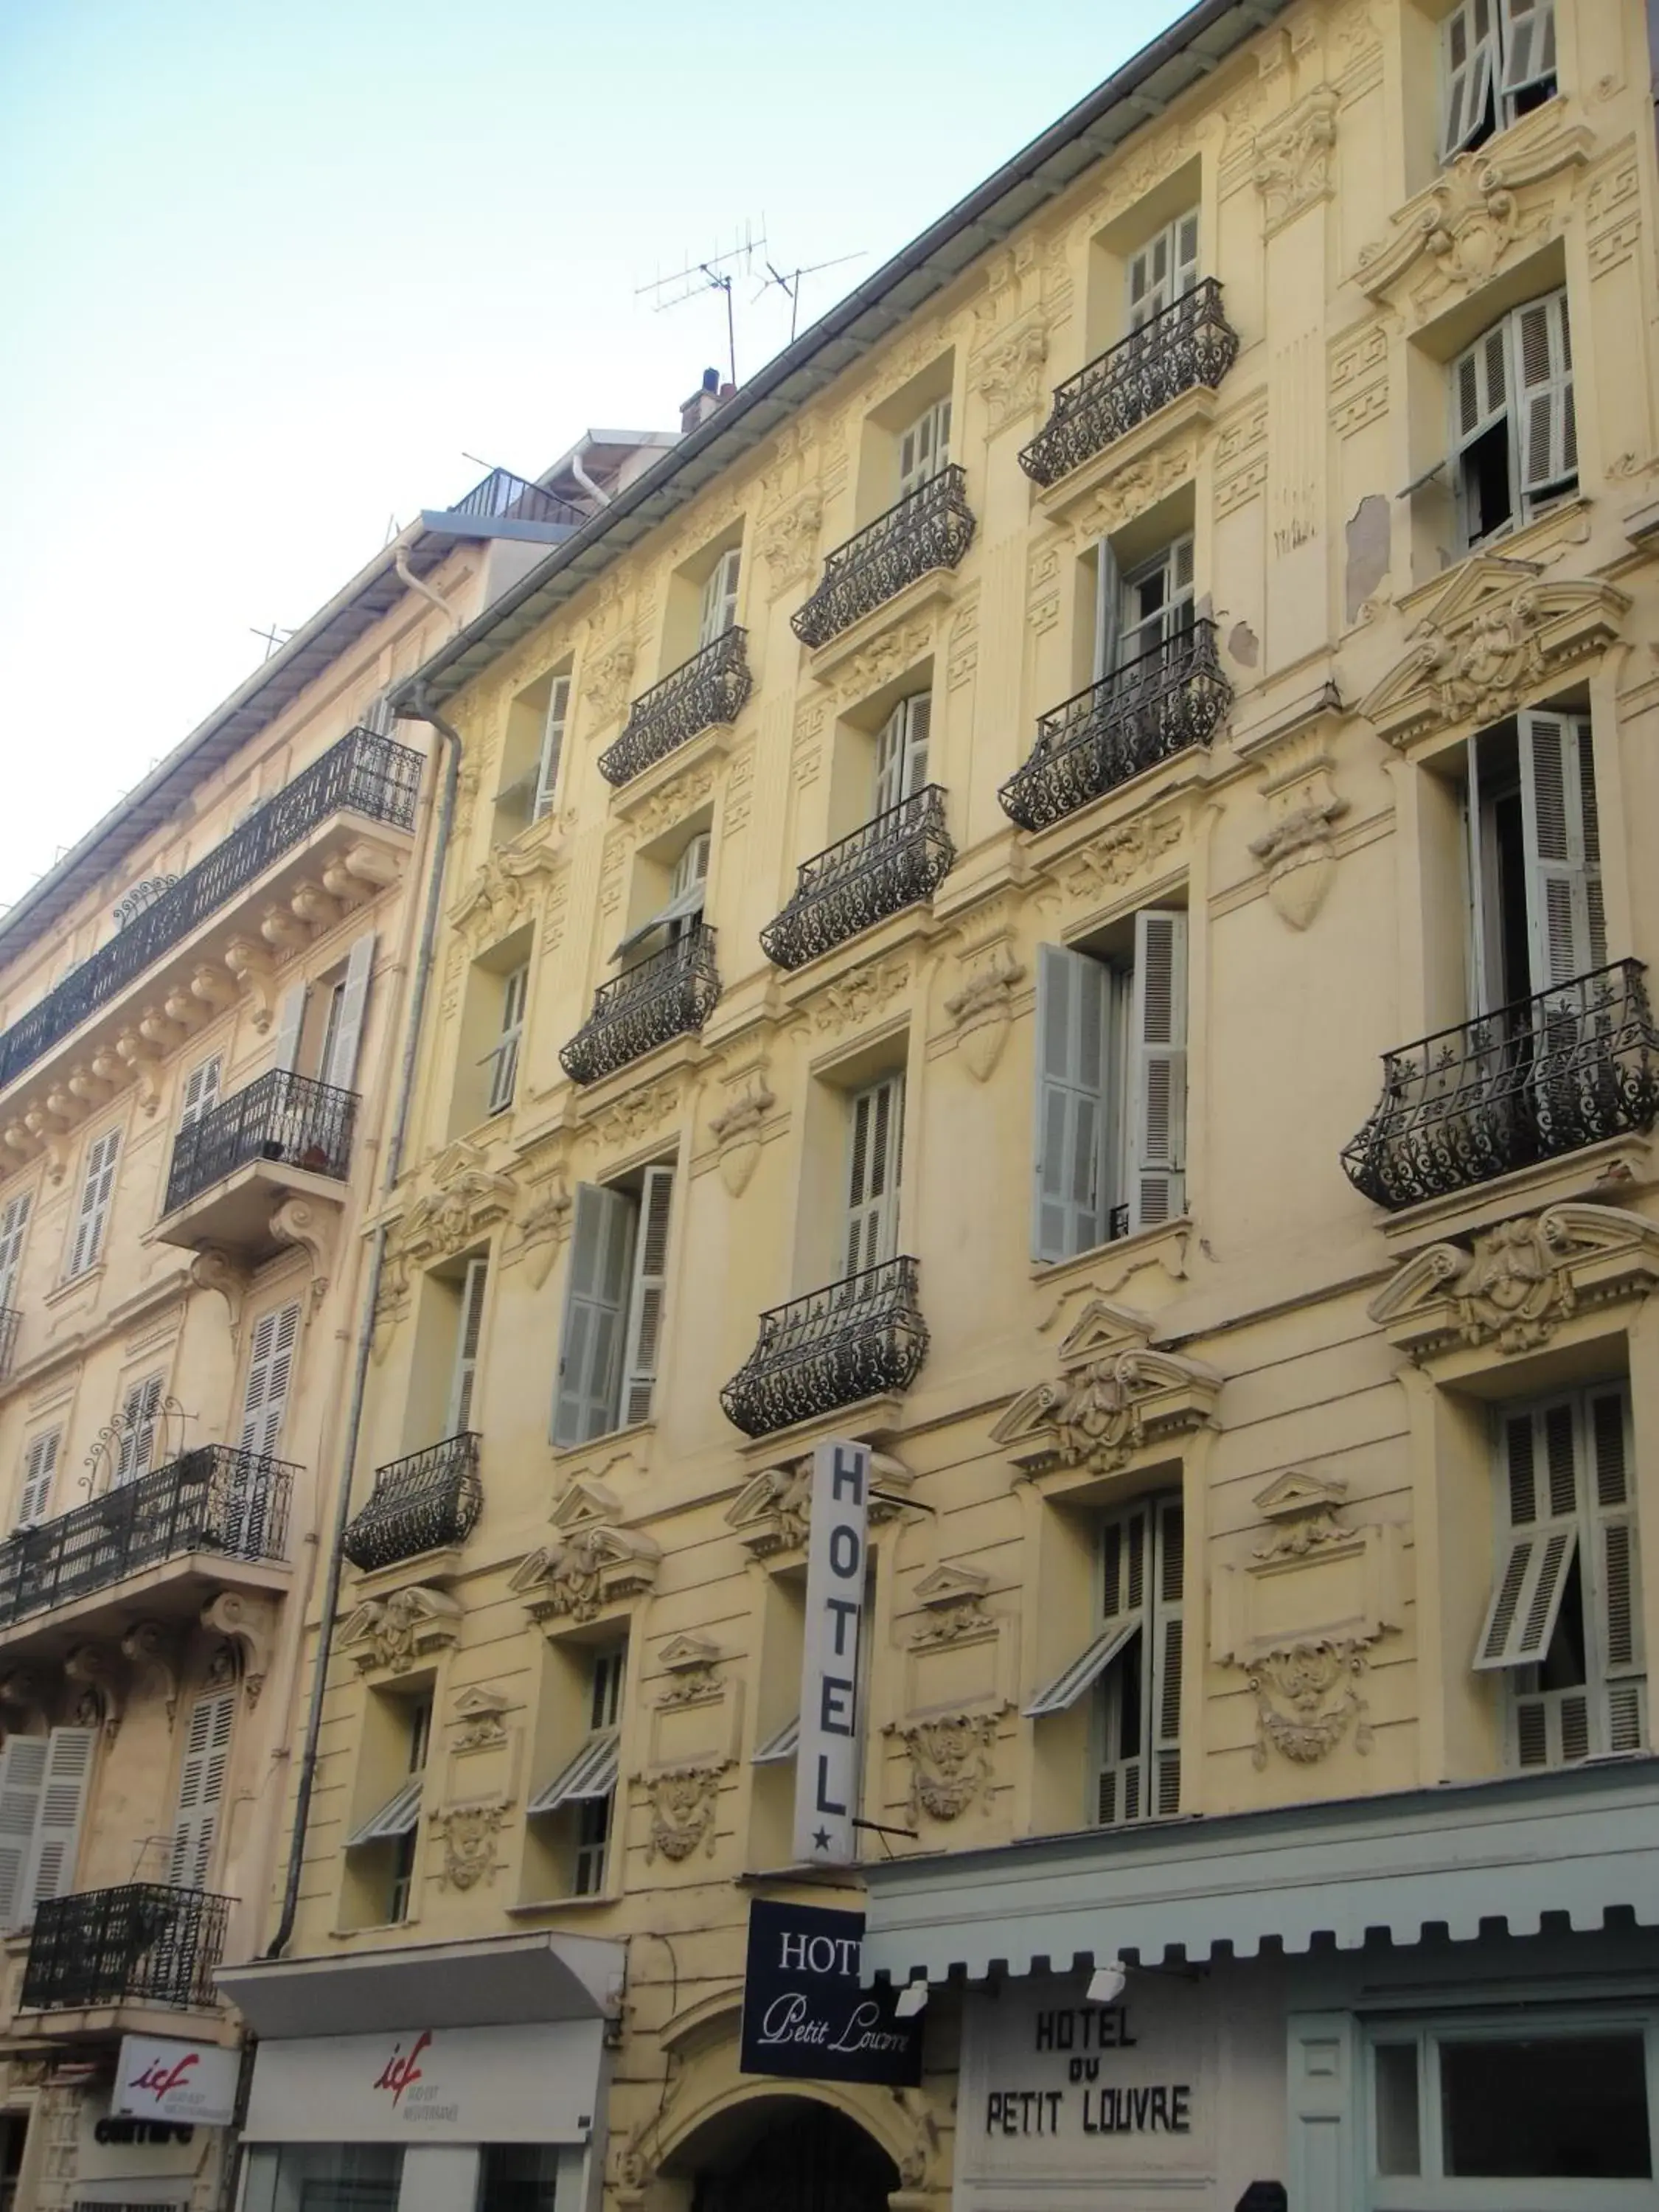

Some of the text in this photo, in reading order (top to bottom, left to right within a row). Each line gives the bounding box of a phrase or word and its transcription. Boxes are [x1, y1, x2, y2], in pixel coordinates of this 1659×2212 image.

[816, 1446, 863, 1816] HOTEL
[757, 1993, 830, 2044] Petit
[1036, 2006, 1138, 2051] HOTEL
[987, 2085, 1192, 2136] PETIT LOUVRE
